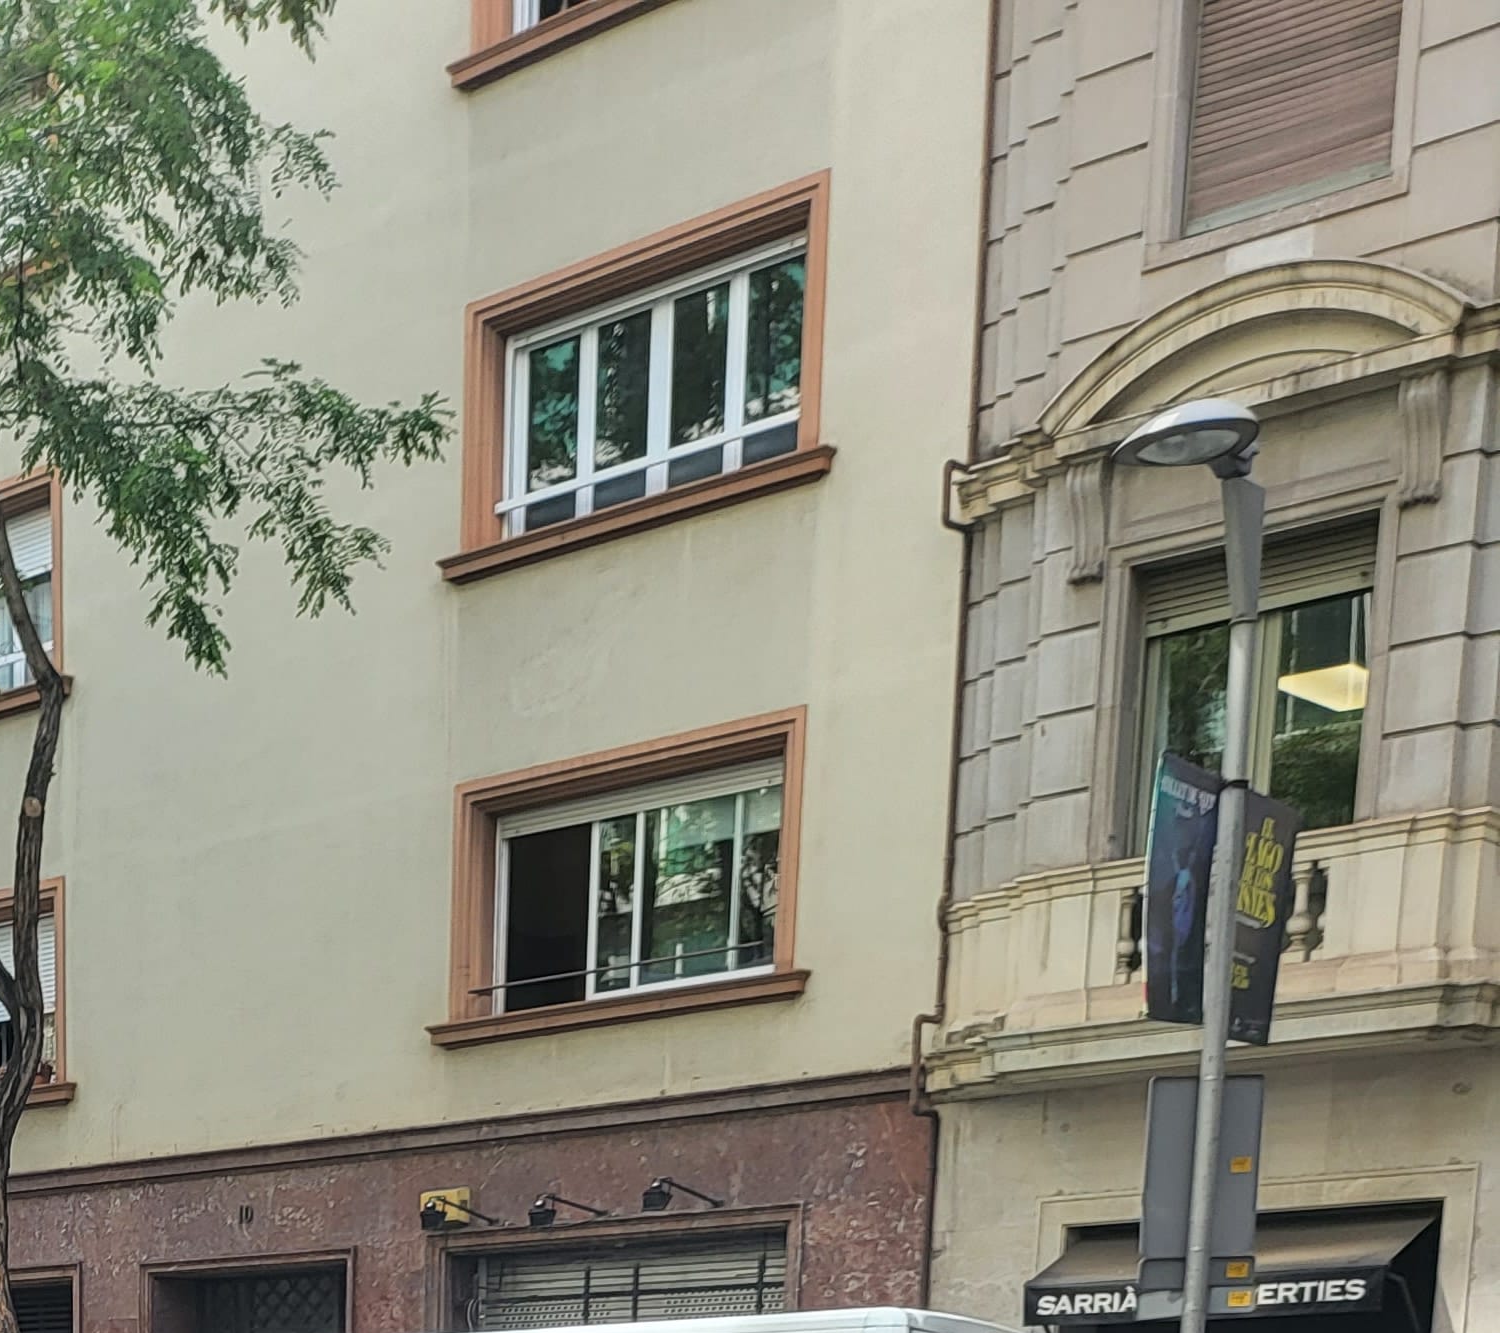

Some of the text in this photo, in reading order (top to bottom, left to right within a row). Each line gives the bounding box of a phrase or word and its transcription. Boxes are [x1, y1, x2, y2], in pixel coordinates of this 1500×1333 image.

[1236, 882, 1277, 928] ISNES
[1036, 1285, 1138, 1316] SARRIÀ
[1256, 1278, 1367, 1306] ERTIES
